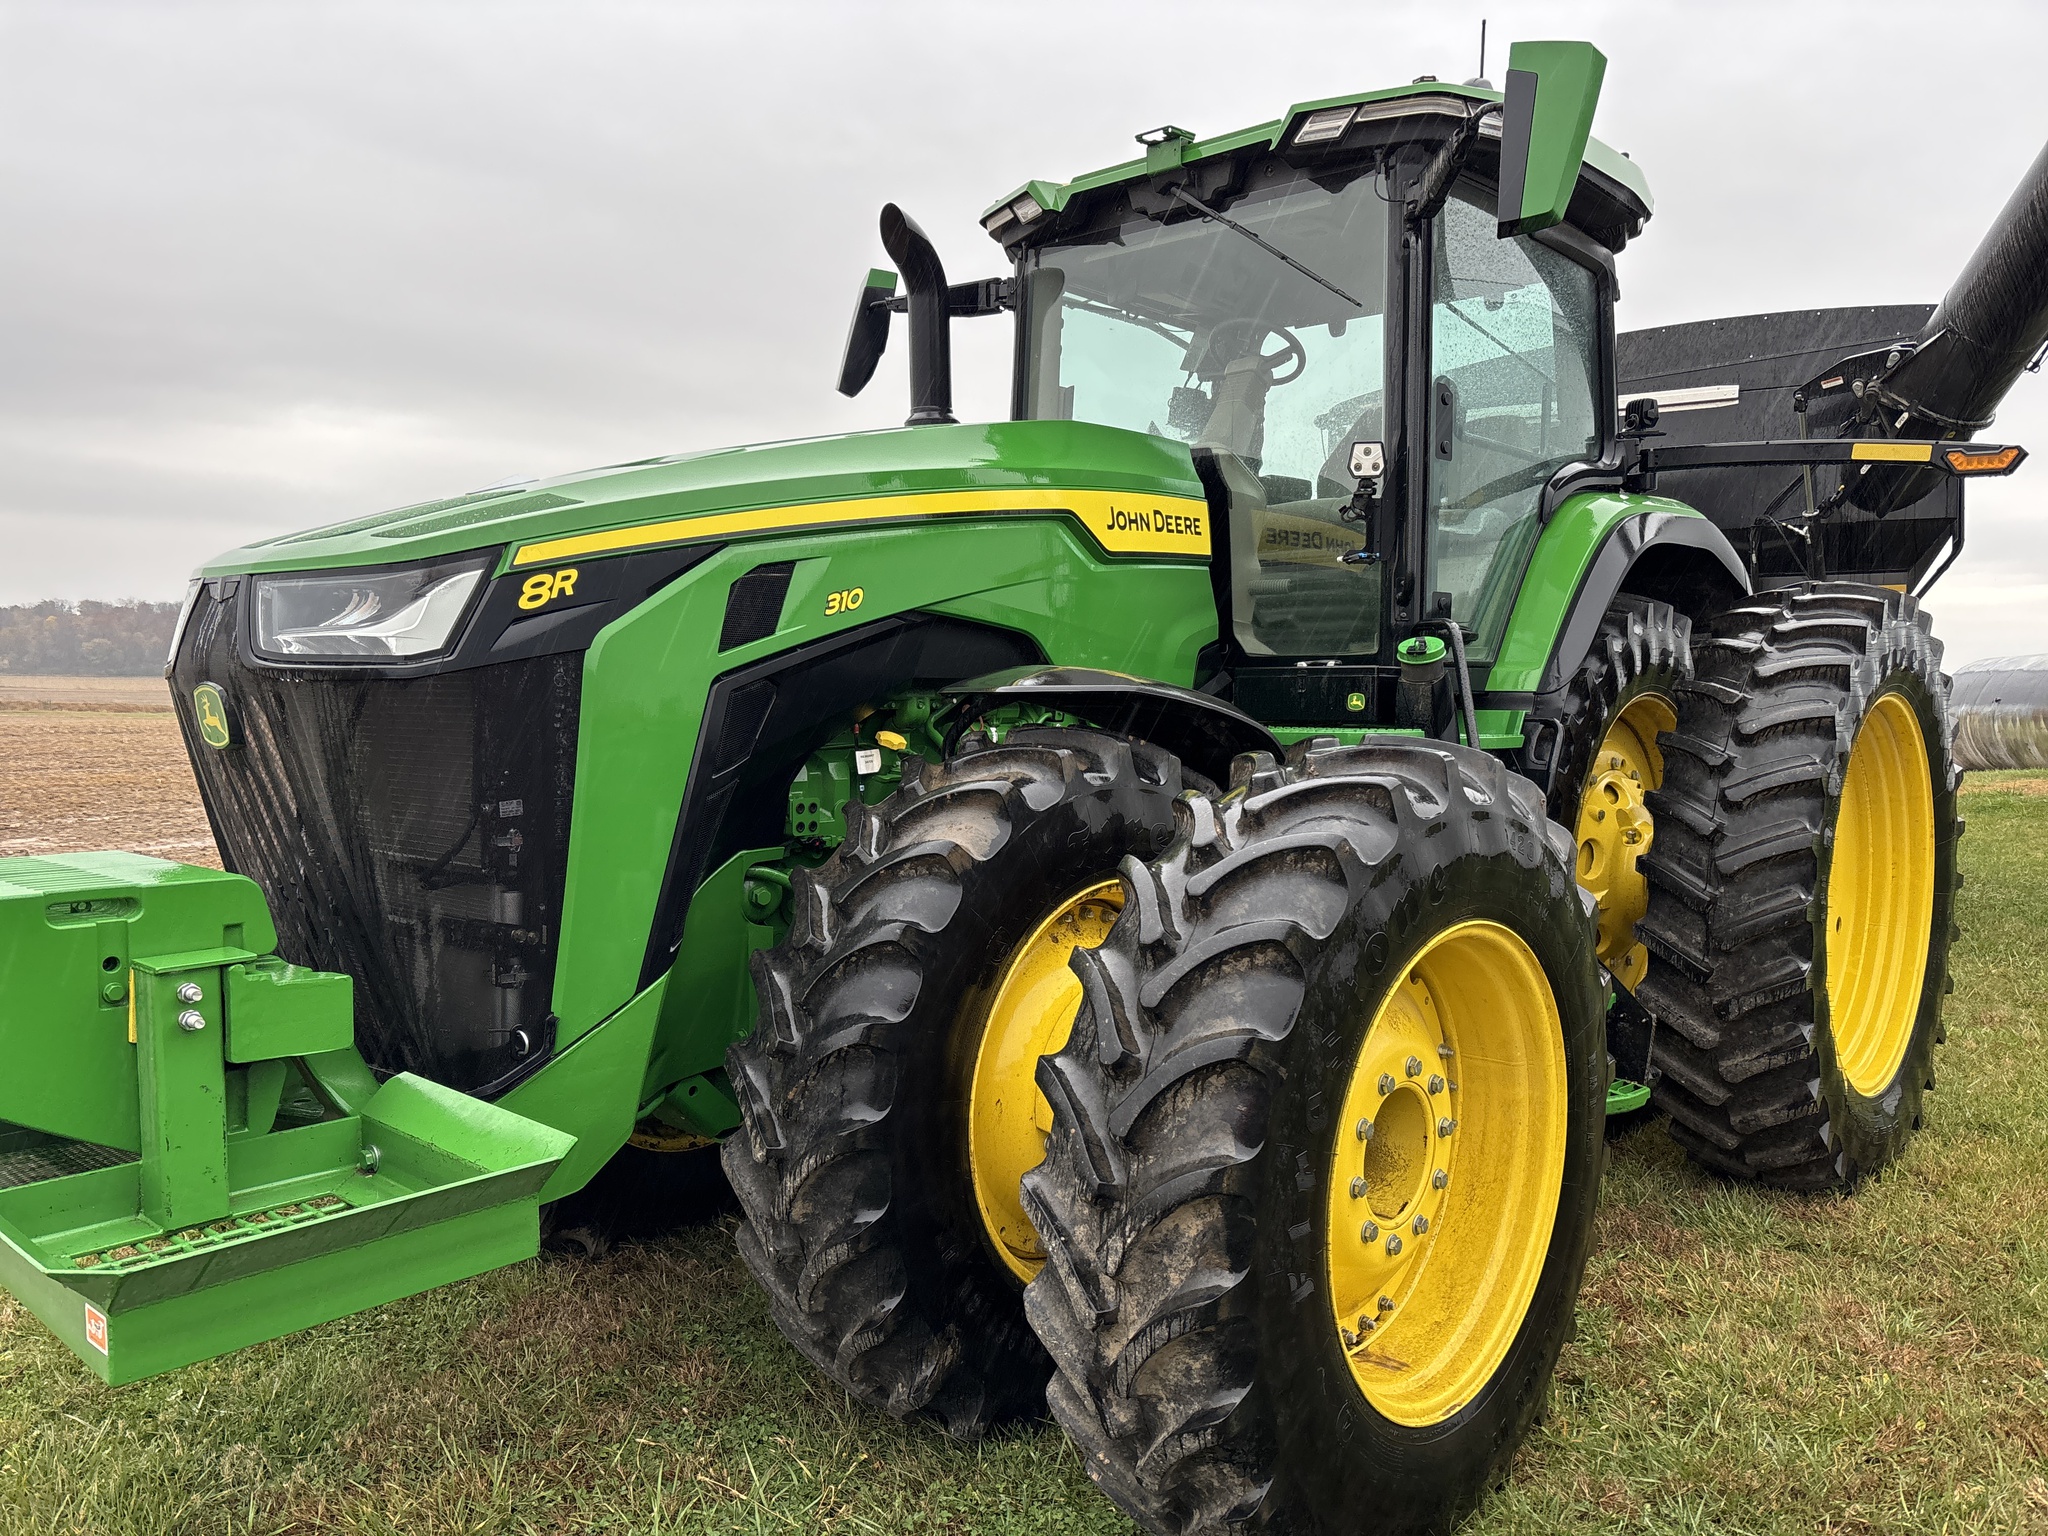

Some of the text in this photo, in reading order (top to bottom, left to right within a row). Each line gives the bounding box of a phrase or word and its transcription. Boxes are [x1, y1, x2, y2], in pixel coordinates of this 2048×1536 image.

[1107, 506, 1202, 536] JOHN DEERE
[518, 569, 578, 610] 8R
[824, 587, 864, 616] 310
